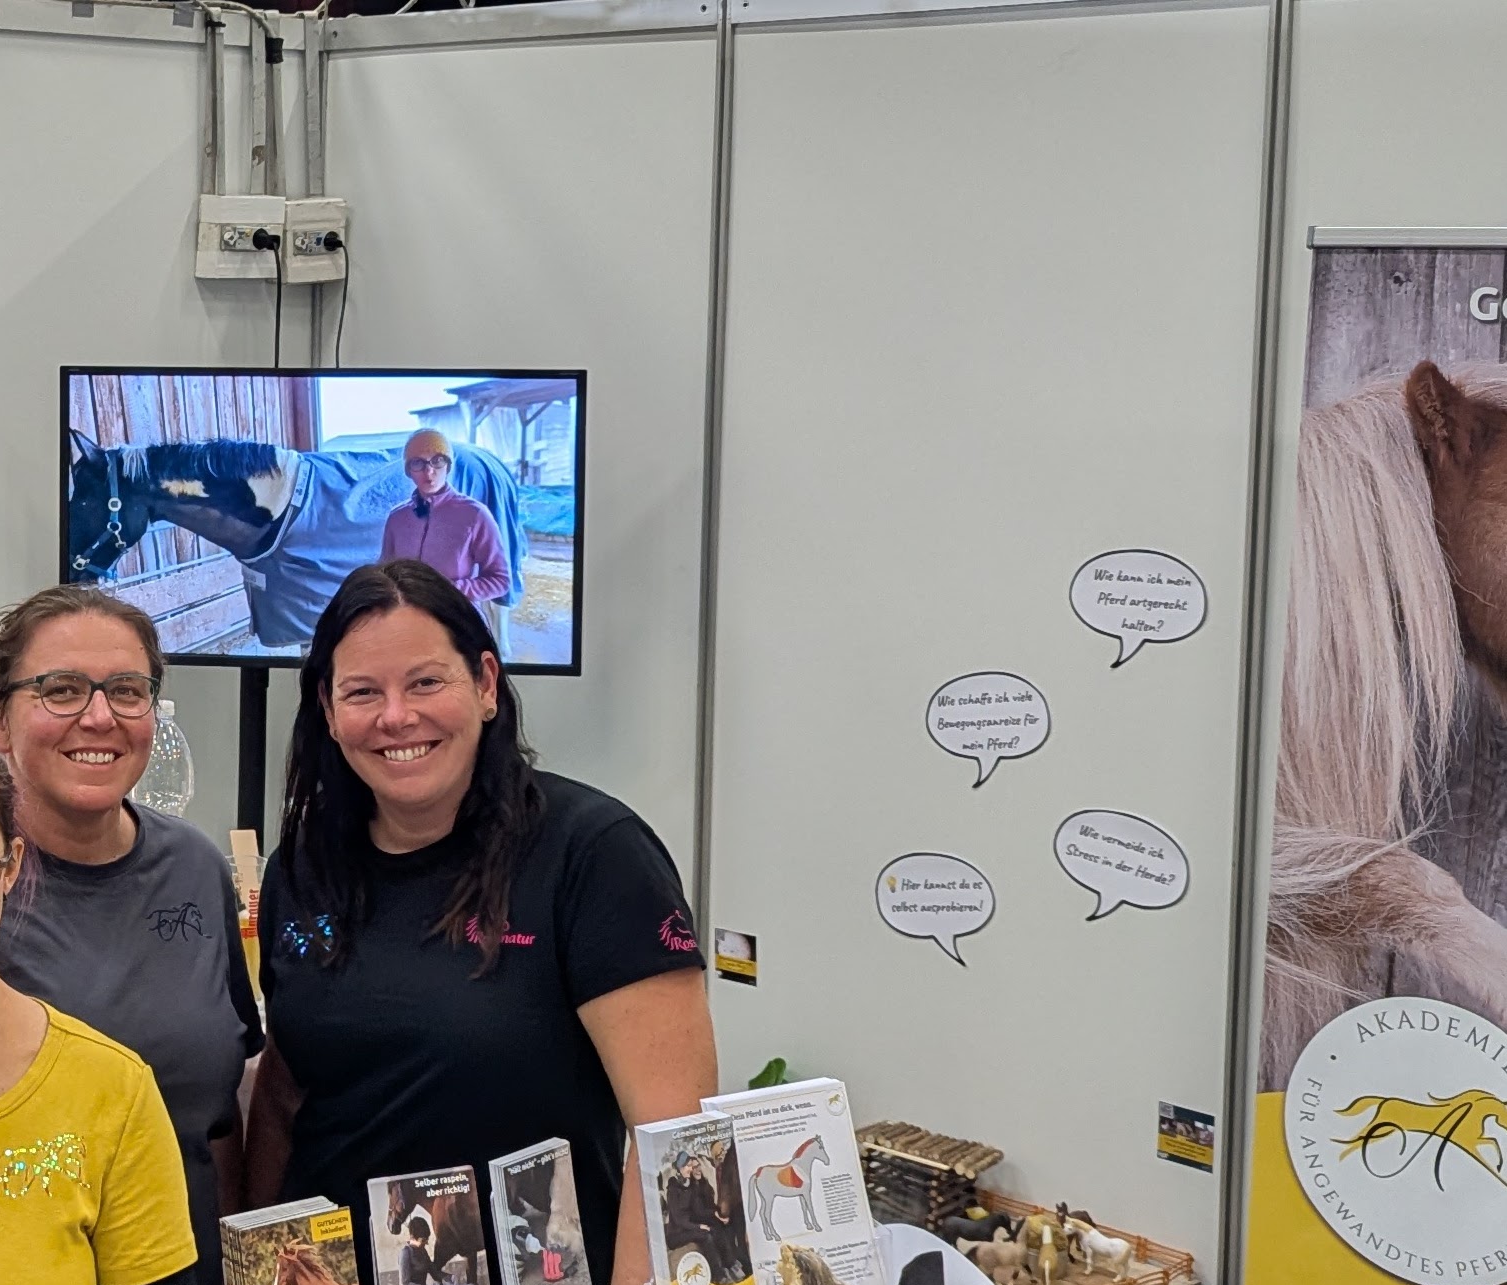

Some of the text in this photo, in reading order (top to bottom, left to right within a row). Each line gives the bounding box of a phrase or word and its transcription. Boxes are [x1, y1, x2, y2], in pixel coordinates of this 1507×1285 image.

[1470, 287, 1507, 321] G
[1094, 569, 1191, 586] Wie kann ich mein
[1097, 592, 1187, 611] Pferd artgerecht
[1121, 618, 1164, 632] halten?
[938, 691, 1032, 707] Wie schaffe ich viele
[1024, 714, 1039, 726] für
[962, 736, 1020, 750] mein Pferd?
[1079, 825, 1164, 859] Wie vermeide ich
[1066, 844, 1175, 885] Stress in der Herde?
[901, 878, 921, 891] Hier
[924, 879, 956, 889] kannst
[959, 879, 970, 889] du
[892, 900, 983, 914] selbst ausprobieren!
[1299, 1078, 1323, 1122] FÜR
[746, 1110, 762, 1119] Pferd
[763, 1108, 771, 1116] ist
[780, 1104, 794, 1113] dick,
[707, 1123, 716, 1131] für
[415, 1173, 469, 1187] Selber raspeln,
[426, 1184, 470, 1197] aber richtig!
[1301, 1135, 1444, 1276] ANGEWANDTES
